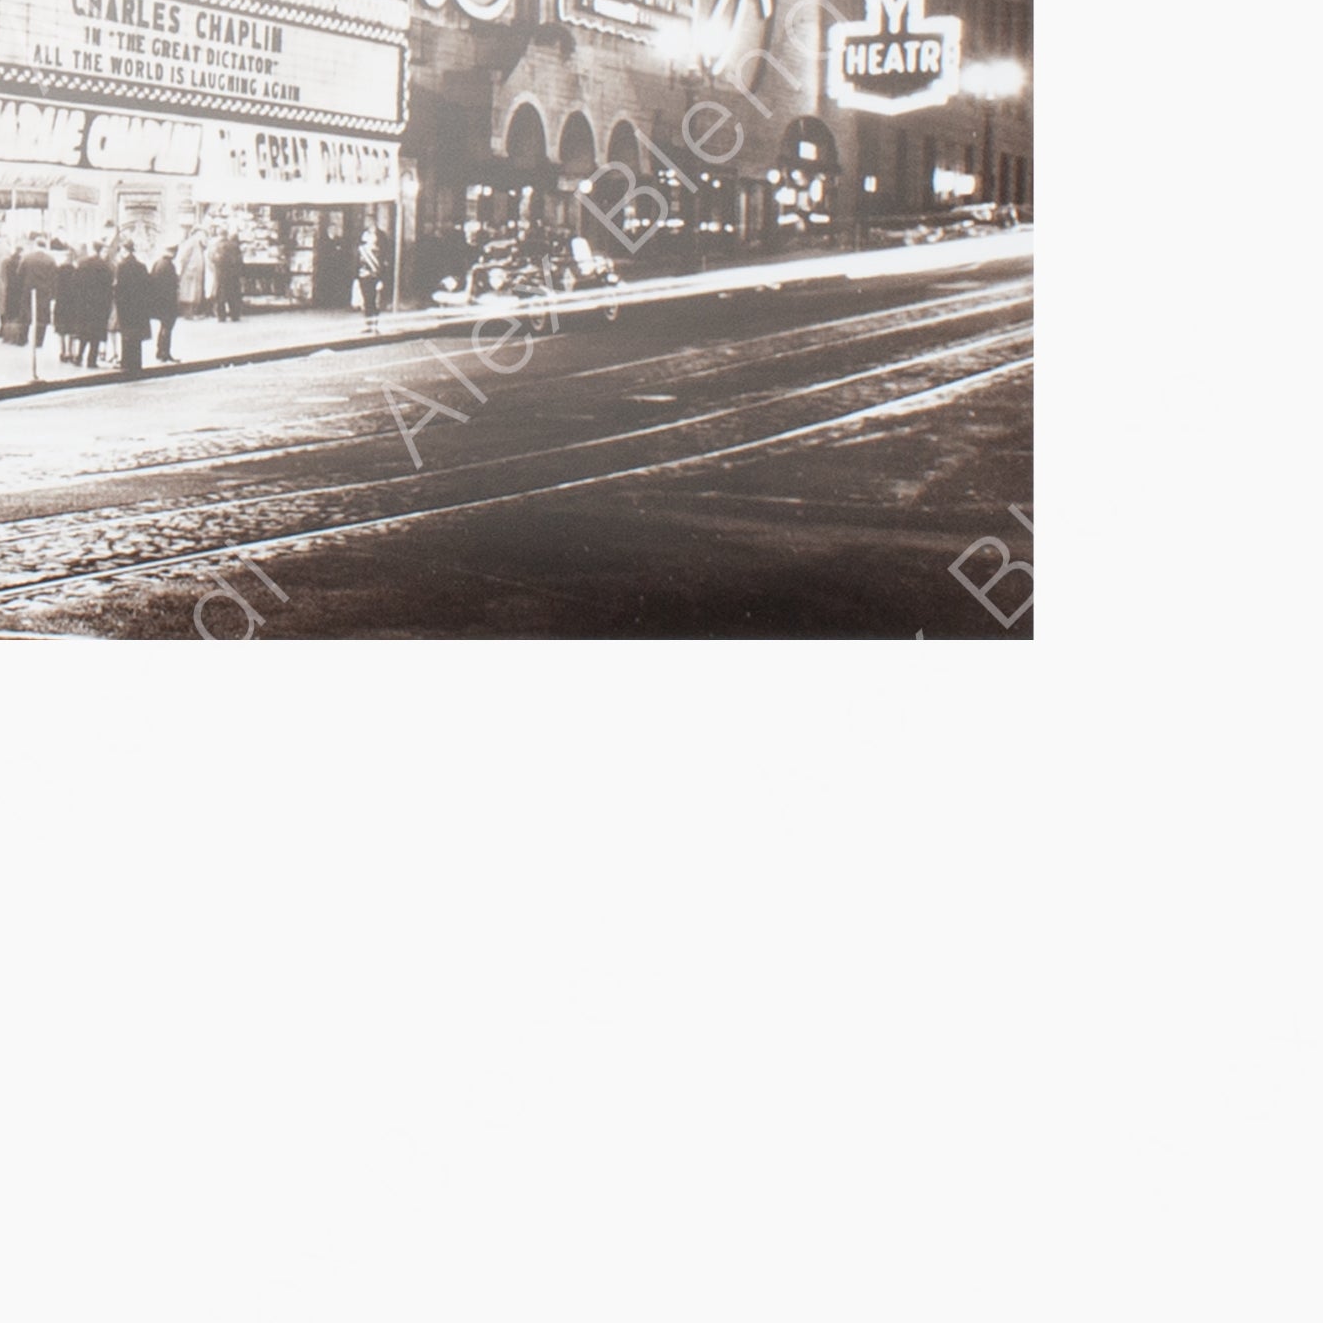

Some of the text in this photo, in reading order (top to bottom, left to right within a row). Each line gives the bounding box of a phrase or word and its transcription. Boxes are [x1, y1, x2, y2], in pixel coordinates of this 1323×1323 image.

[84, 26, 101, 46] IN
[151, 37, 202, 64] GREAT
[195, 11, 284, 53] CHAPLIN
[33, 43, 302, 103] ALL THE WORLD IS LAUGHING AGAIN
